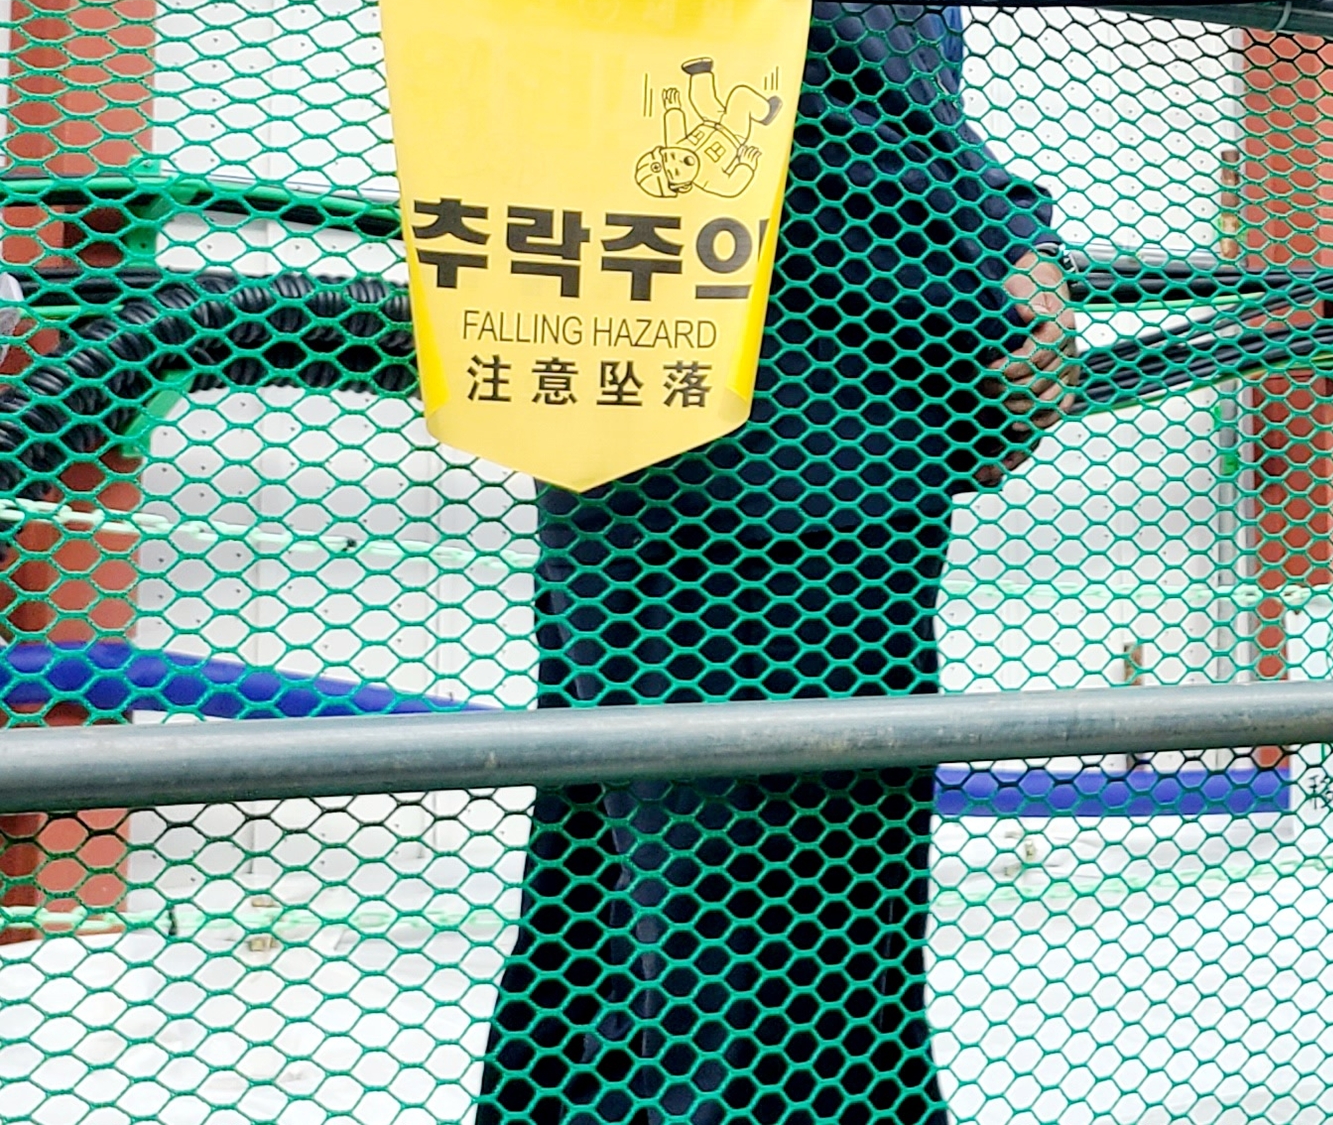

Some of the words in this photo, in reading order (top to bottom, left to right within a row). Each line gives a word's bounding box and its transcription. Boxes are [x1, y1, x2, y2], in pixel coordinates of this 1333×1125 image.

[412, 196, 771, 302] 추락주의
[462, 309, 584, 346] FALLING
[593, 316, 718, 349] HAZARD
[465, 353, 714, 409] 注意坠落
